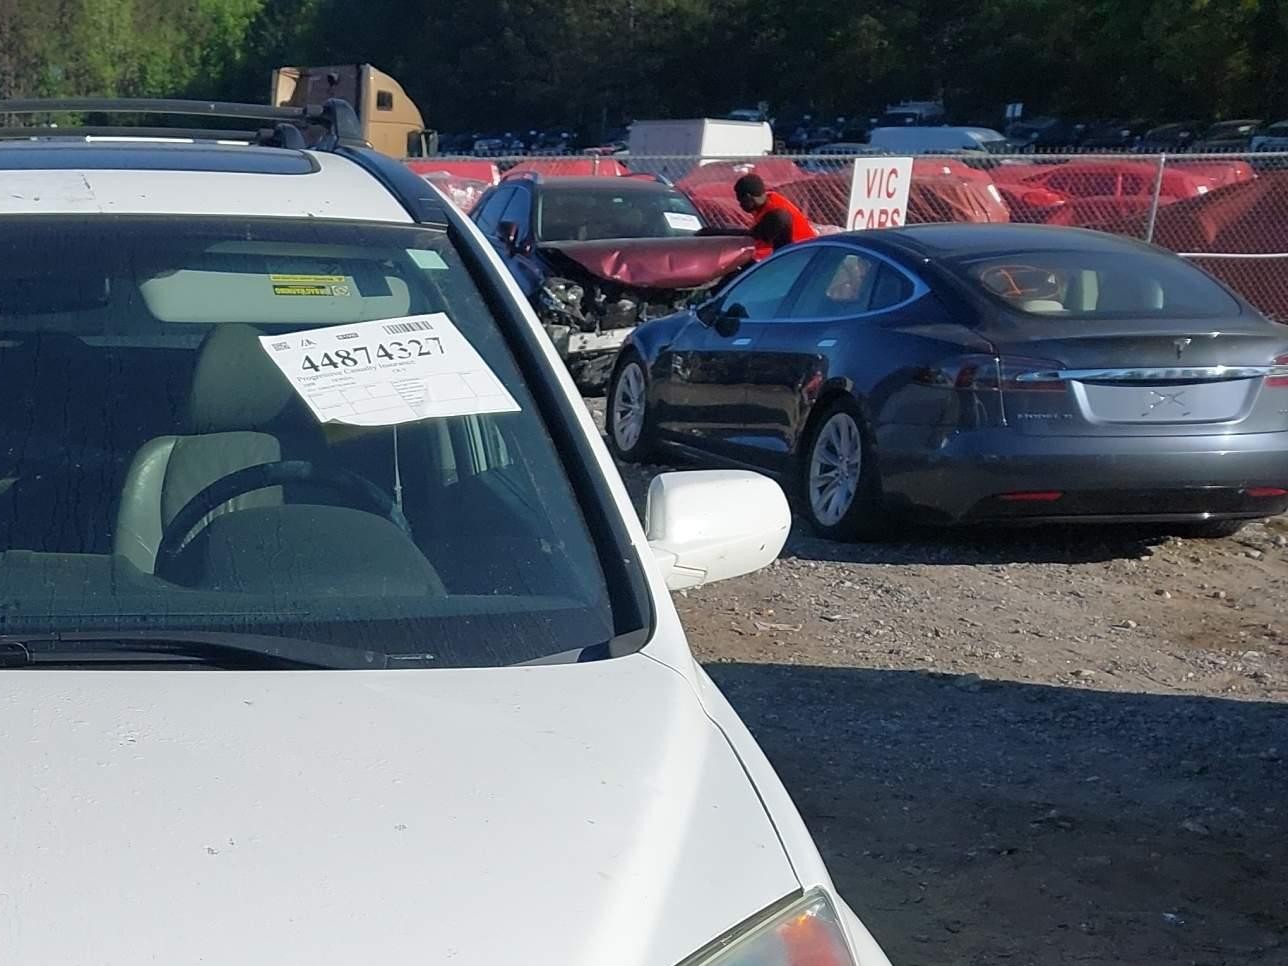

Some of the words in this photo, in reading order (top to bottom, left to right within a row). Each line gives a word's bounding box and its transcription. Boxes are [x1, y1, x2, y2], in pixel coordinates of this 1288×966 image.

[866, 168, 899, 199] VIC
[853, 208, 901, 231] CARS
[301, 337, 445, 372] 44874327
